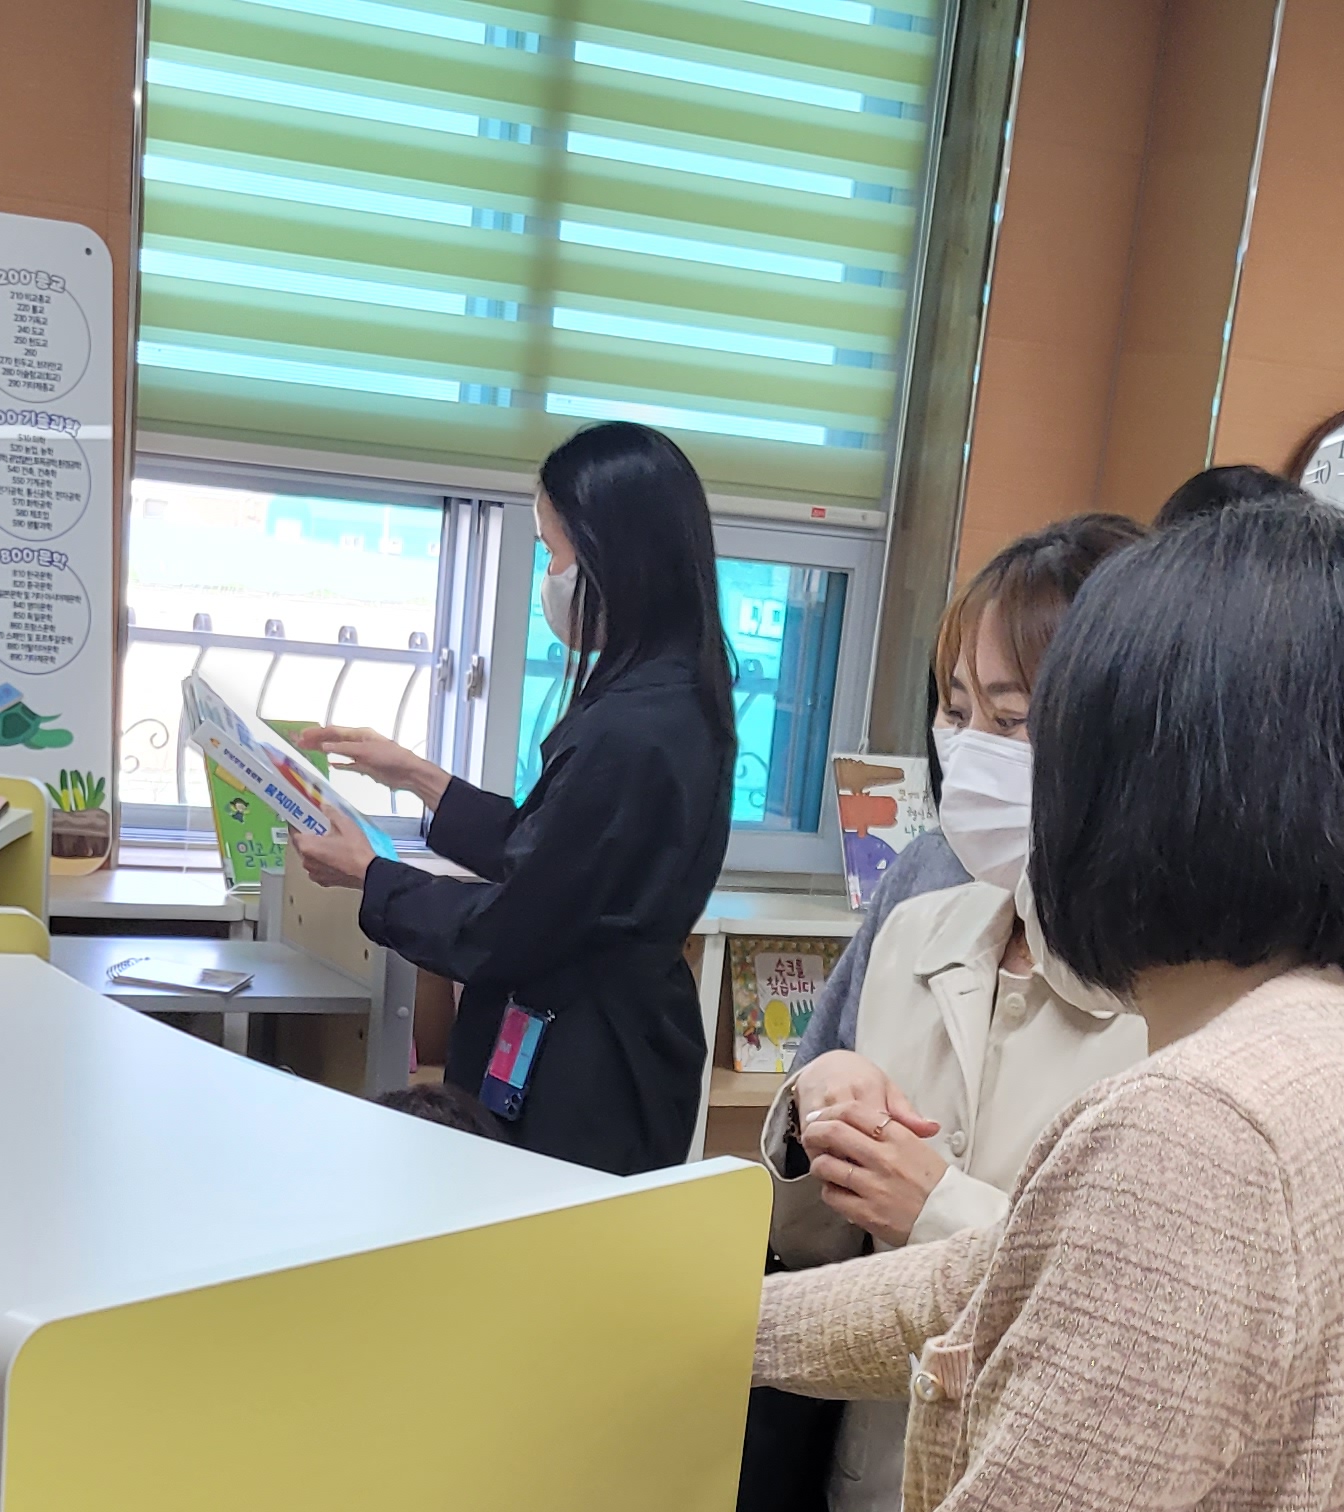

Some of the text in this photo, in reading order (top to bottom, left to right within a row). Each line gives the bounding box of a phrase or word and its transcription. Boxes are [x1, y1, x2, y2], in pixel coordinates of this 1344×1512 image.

[20, 409, 81, 437] 기술과학
[1313, 460, 1332, 484] 10
[0, 547, 69, 571] 800 문학
[264, 783, 304, 820] 움직이는
[766, 976, 816, 997] 찾습니다
